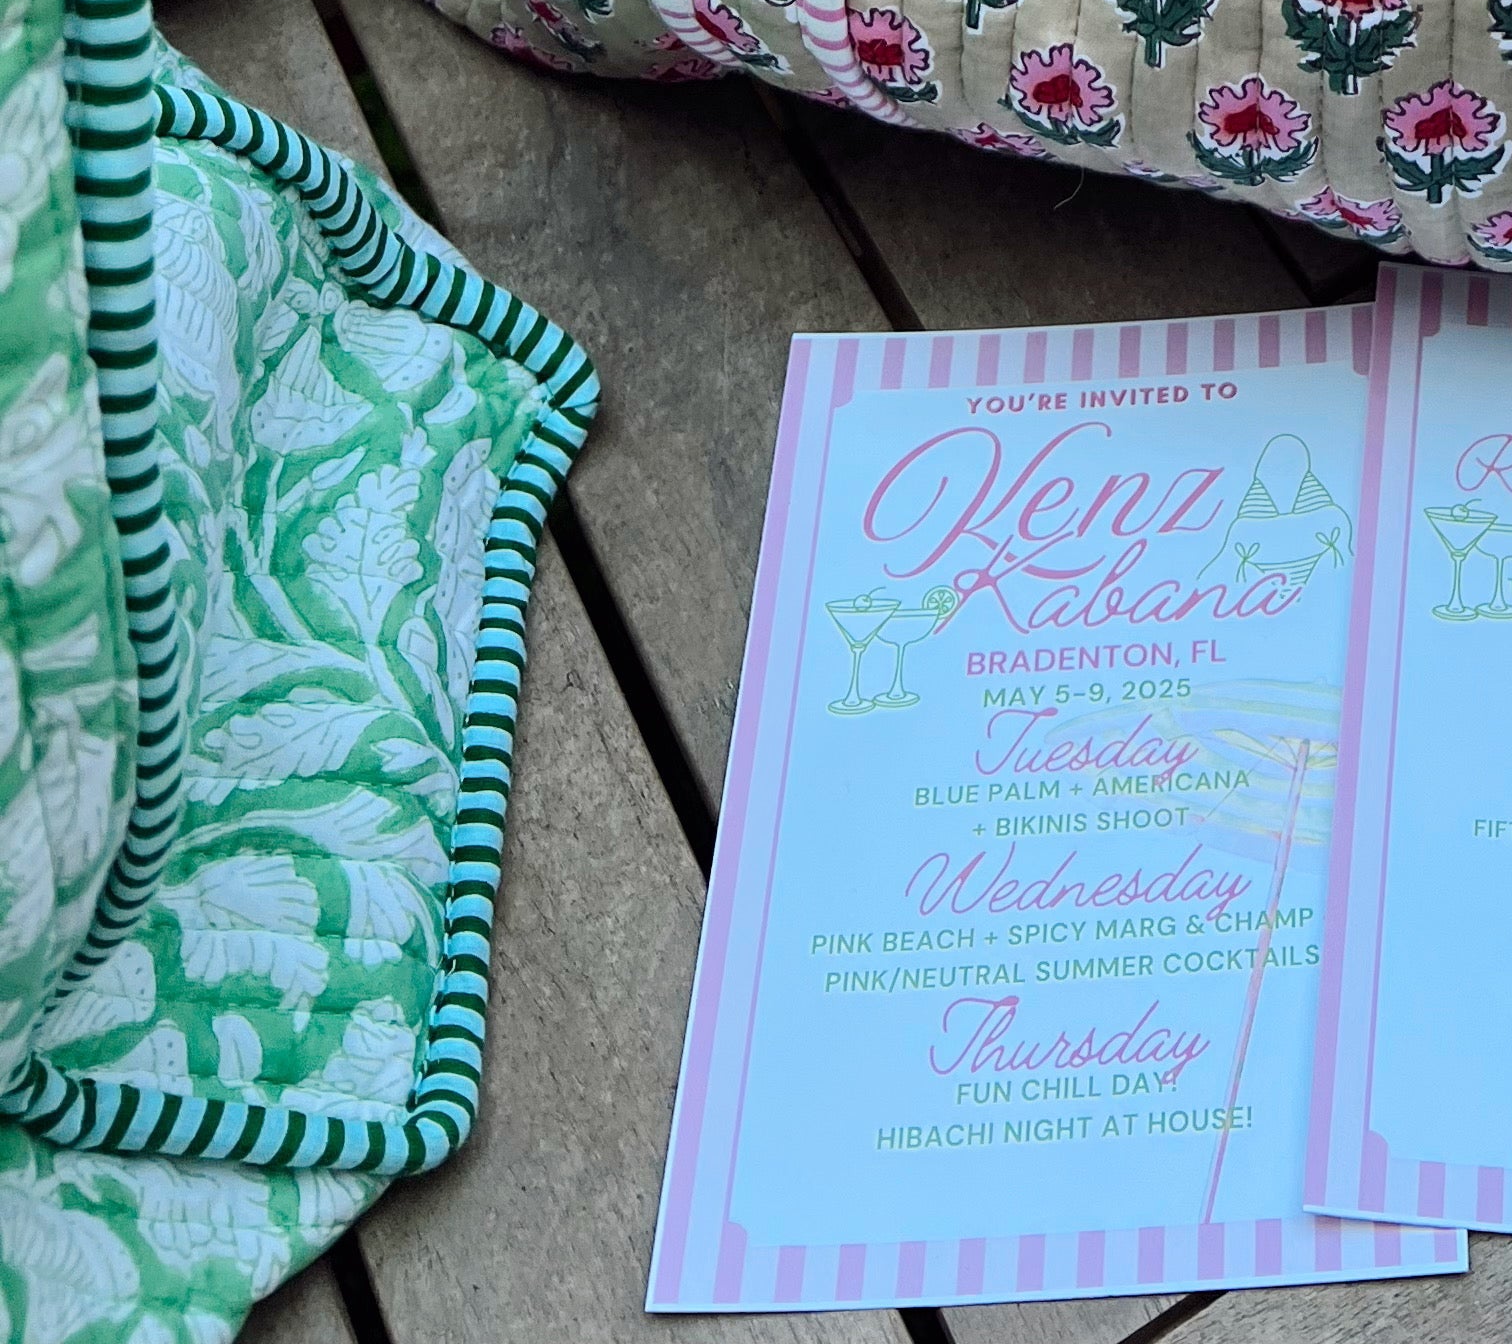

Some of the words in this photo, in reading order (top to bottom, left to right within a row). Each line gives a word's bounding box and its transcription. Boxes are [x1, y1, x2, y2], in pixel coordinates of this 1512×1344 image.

[967, 392, 1068, 415] YOU'RE
[1079, 385, 1190, 410] INVITED
[1200, 382, 1239, 402] TO
[862, 421, 1225, 580] Kenz
[933, 537, 1303, 635] Kabana
[966, 642, 1181, 677] BRADENTON,
[1190, 640, 1227, 665] FL
[983, 684, 1047, 708] MAY
[1121, 678, 1192, 701] 2025
[975, 709, 1201, 787] Tuesday
[914, 784, 980, 807] BLUE
[987, 780, 1061, 804] PALM
[1069, 782, 1083, 797] +
[1092, 768, 1251, 796] AMERICANA
[971, 821, 987, 837] +
[994, 812, 1088, 837] BIKINIS
[1096, 806, 1189, 832] SHOOT
[904, 842, 1252, 923] Wednesday
[811, 932, 873, 955] PINK
[881, 927, 978, 954] BEACH
[984, 929, 999, 945] +
[1007, 921, 1087, 947] SPICY
[1094, 914, 1177, 940] MARG
[1185, 914, 1206, 935] &
[1213, 907, 1315, 934] CHAMP
[824, 961, 1027, 994] PINK/NEUTRAL
[1034, 952, 1154, 982] SUMMER
[1161, 944, 1321, 974] COCKTAILS
[928, 995, 1210, 1084] Thursday
[956, 1080, 1013, 1106] FUN
[1020, 1074, 1102, 1103] CHILL
[1111, 1071, 1179, 1098] DAY!
[876, 1122, 996, 1151] HIBACHI
[1003, 1117, 1093, 1145] NIGHT
[1100, 1113, 1139, 1139] AT
[1147, 1105, 1254, 1136] HOUSE!
